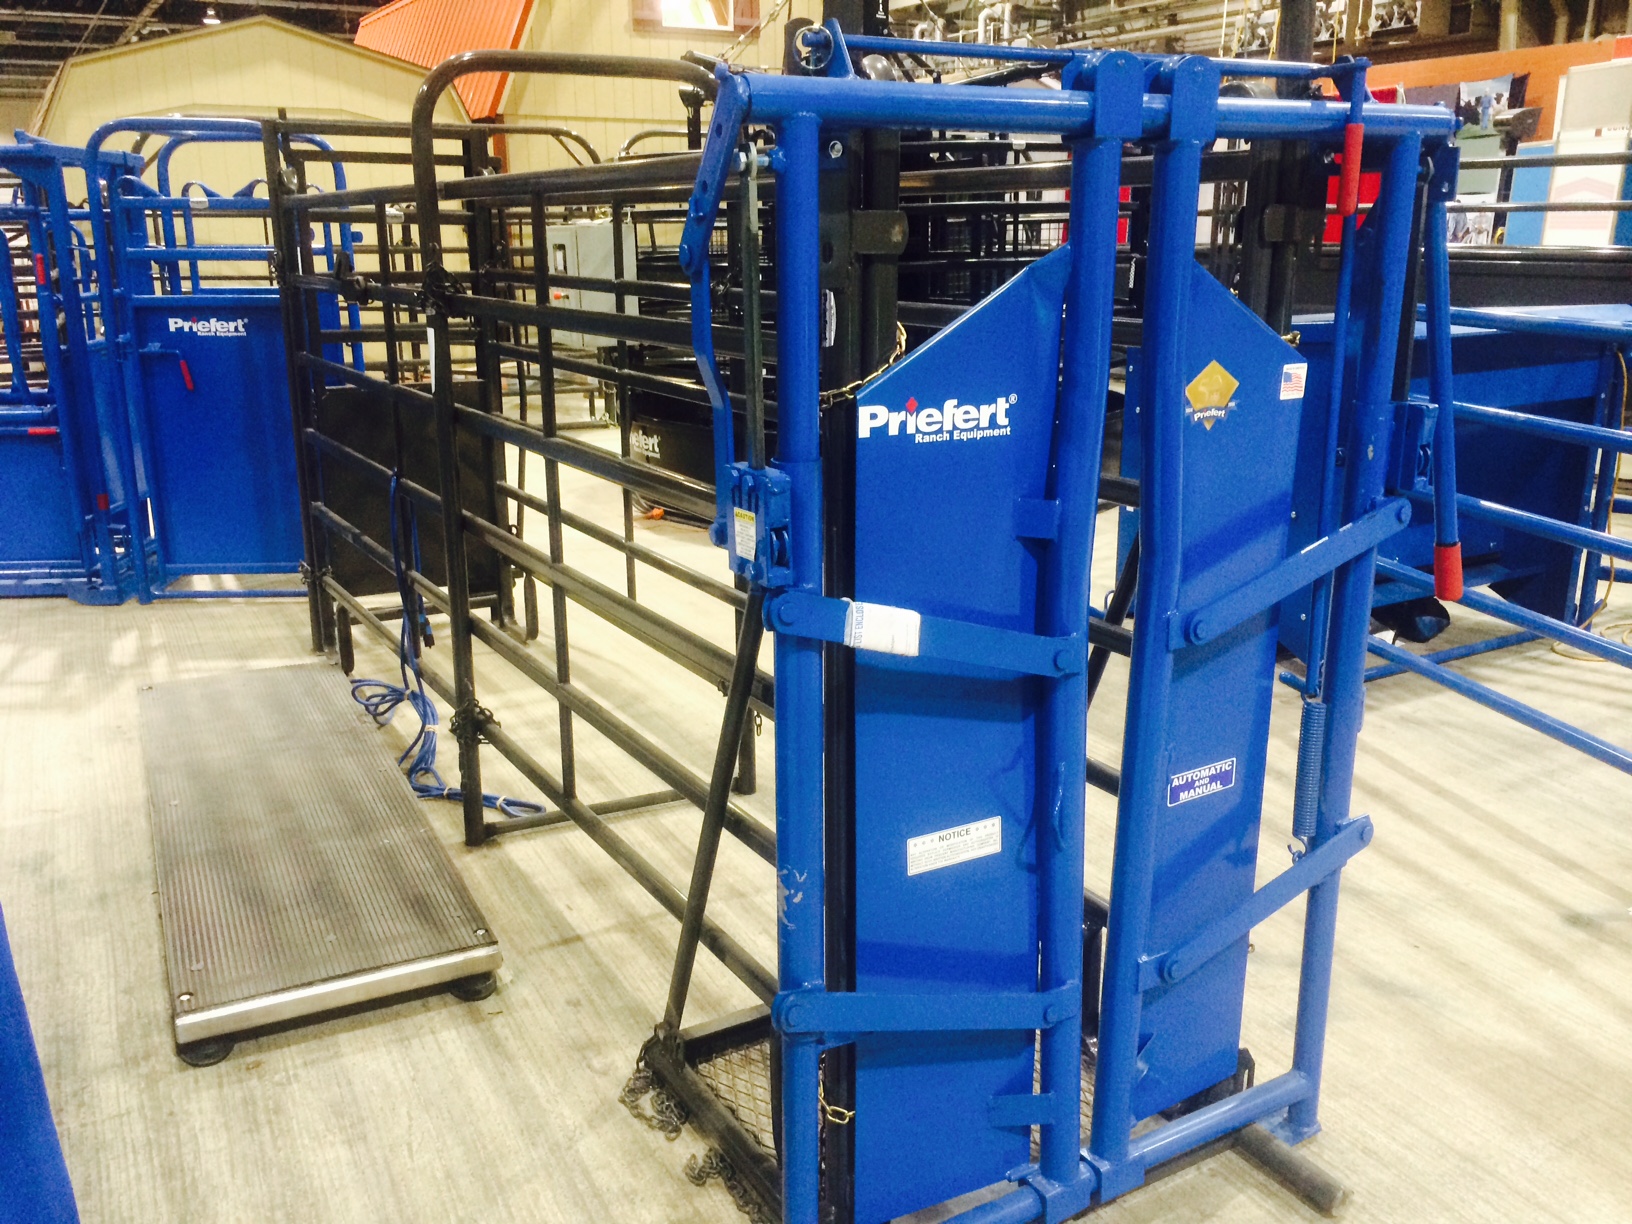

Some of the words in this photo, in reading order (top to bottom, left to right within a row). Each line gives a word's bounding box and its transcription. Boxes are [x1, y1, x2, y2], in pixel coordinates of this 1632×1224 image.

[1193, 408, 1225, 421] Priefert
[915, 433, 950, 443] Ranch
[953, 426, 1011, 441] Equipment
[1172, 762, 1232, 787] AUTOMATIC
[1194, 777, 1210, 787] AND
[1179, 781, 1223, 800] MANUAL
[938, 827, 971, 842] NOTICE
